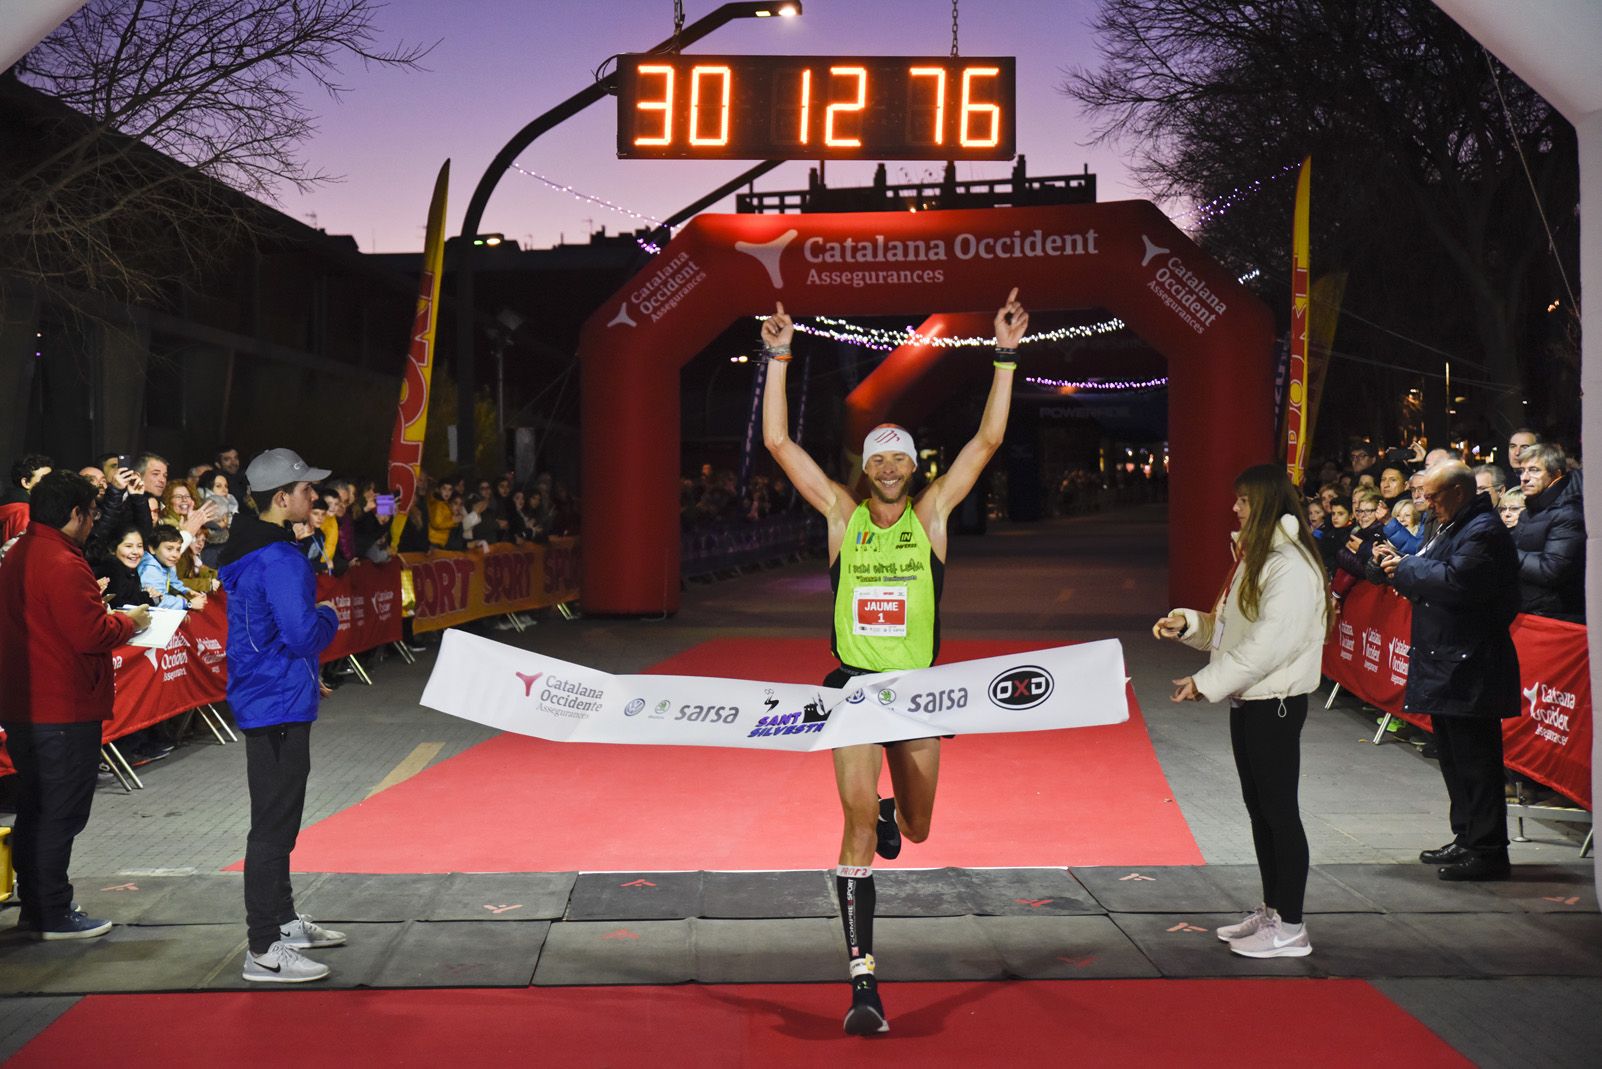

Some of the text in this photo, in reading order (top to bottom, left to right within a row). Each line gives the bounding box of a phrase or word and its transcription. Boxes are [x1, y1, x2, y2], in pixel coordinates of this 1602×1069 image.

[634, 64, 1000, 148] 30 12 76
[803, 228, 1098, 263] Catalana Occident
[631, 252, 689, 304] Catalana
[640, 261, 700, 314] Occident
[805, 267, 945, 288] Assegurances
[1168, 257, 1227, 315] Catalana
[650, 272, 706, 323] Assegurances
[1147, 280, 1205, 335] Assegurances
[1155, 268, 1216, 327] Occident
[864, 601, 899, 611] JAUME
[878, 612, 885, 623] 1
[546, 675, 604, 699] Catalana
[907, 687, 968, 713] sarsa
[997, 677, 1046, 700] OXD
[540, 689, 603, 712] Occidente
[675, 705, 739, 724] sarsa
[756, 712, 802, 728] SANT
